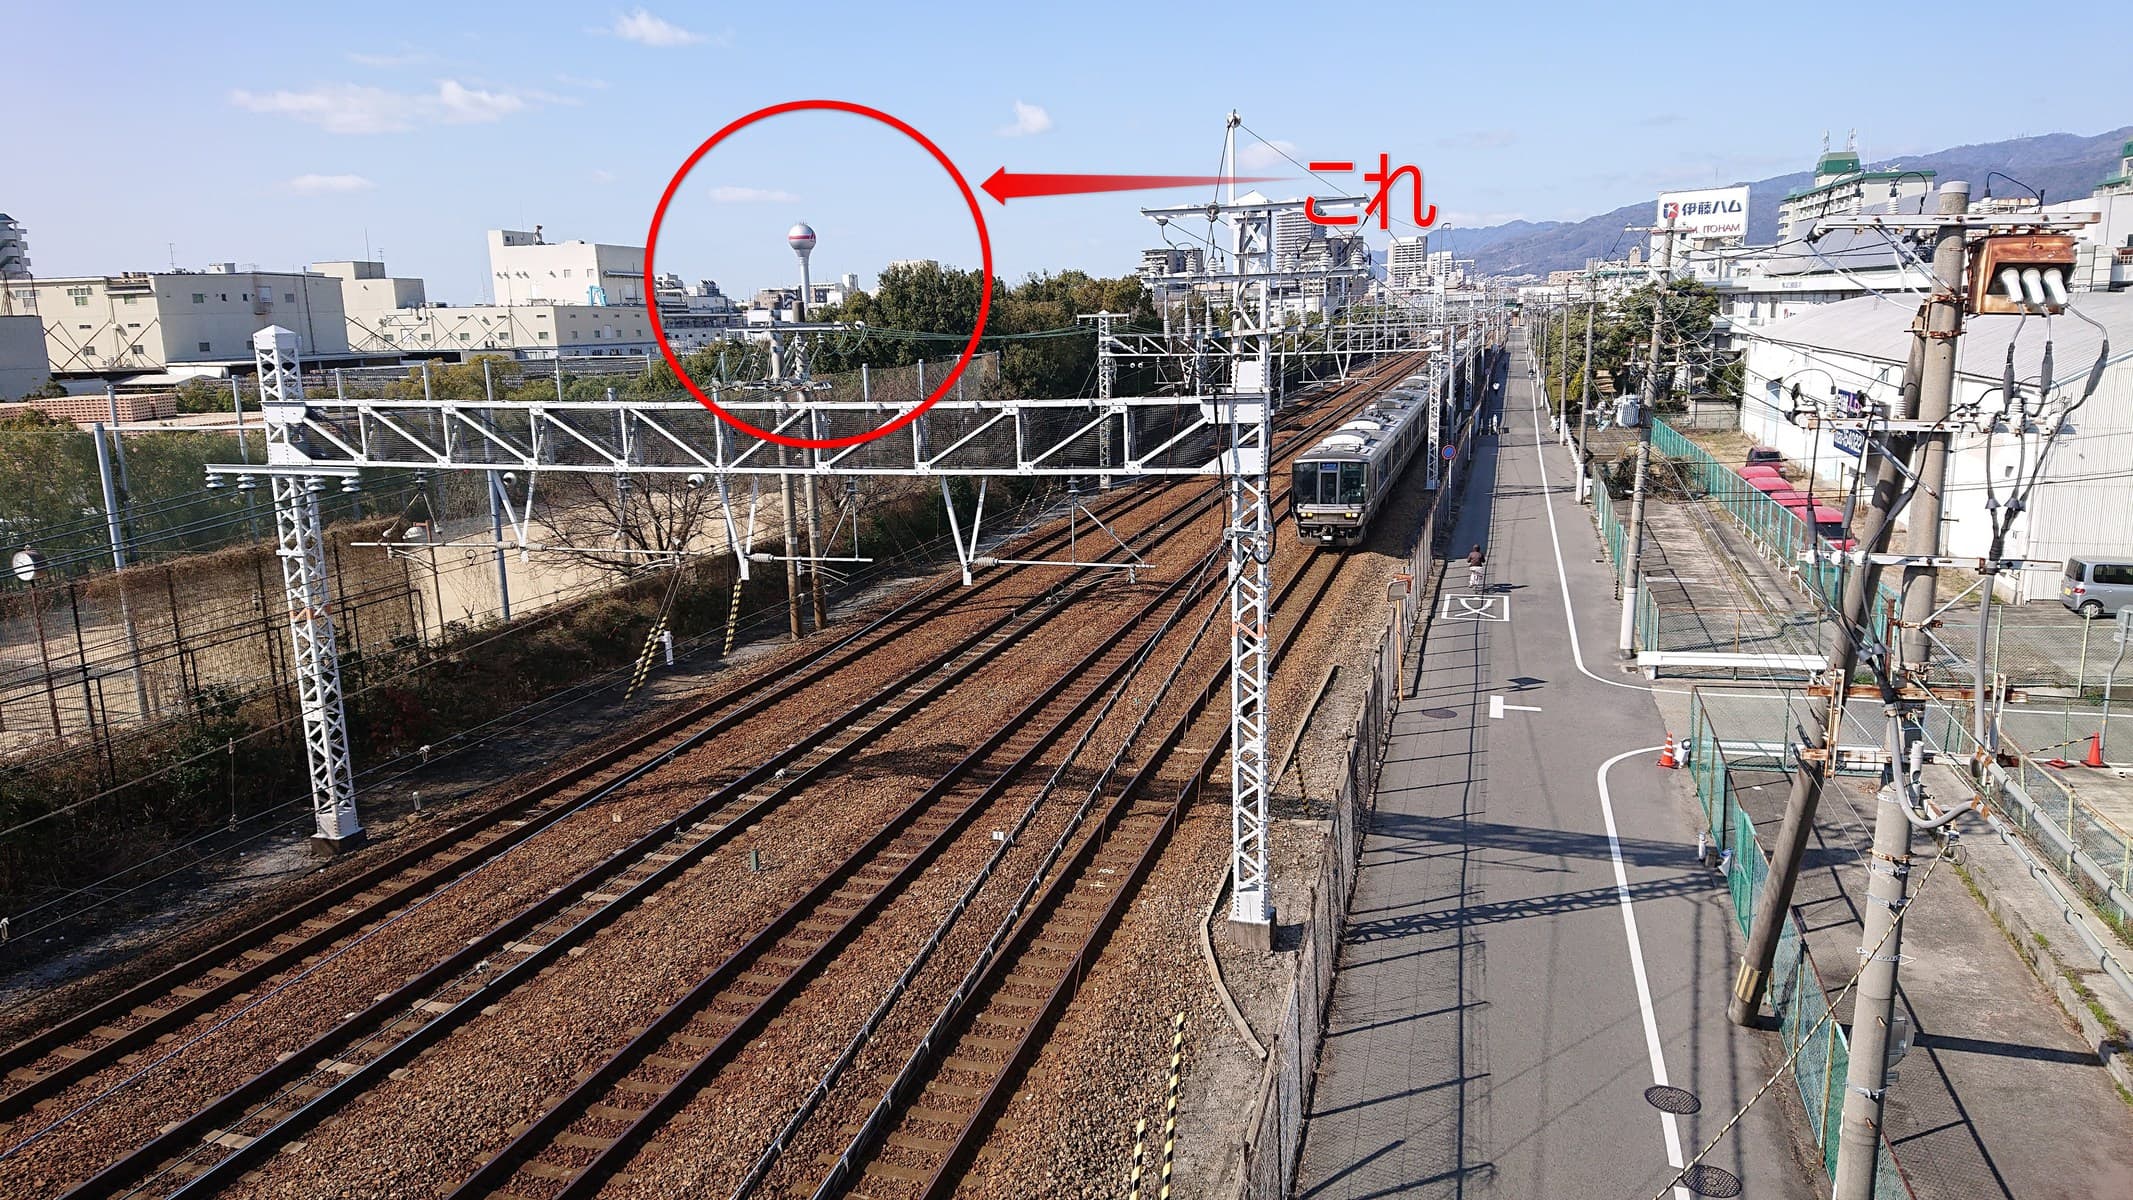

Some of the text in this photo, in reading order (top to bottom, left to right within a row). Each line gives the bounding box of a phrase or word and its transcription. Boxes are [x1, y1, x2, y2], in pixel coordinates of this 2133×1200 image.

[1682, 200, 1742, 216] 伊藤ハム
[1703, 224, 1740, 233] ITOHAM
